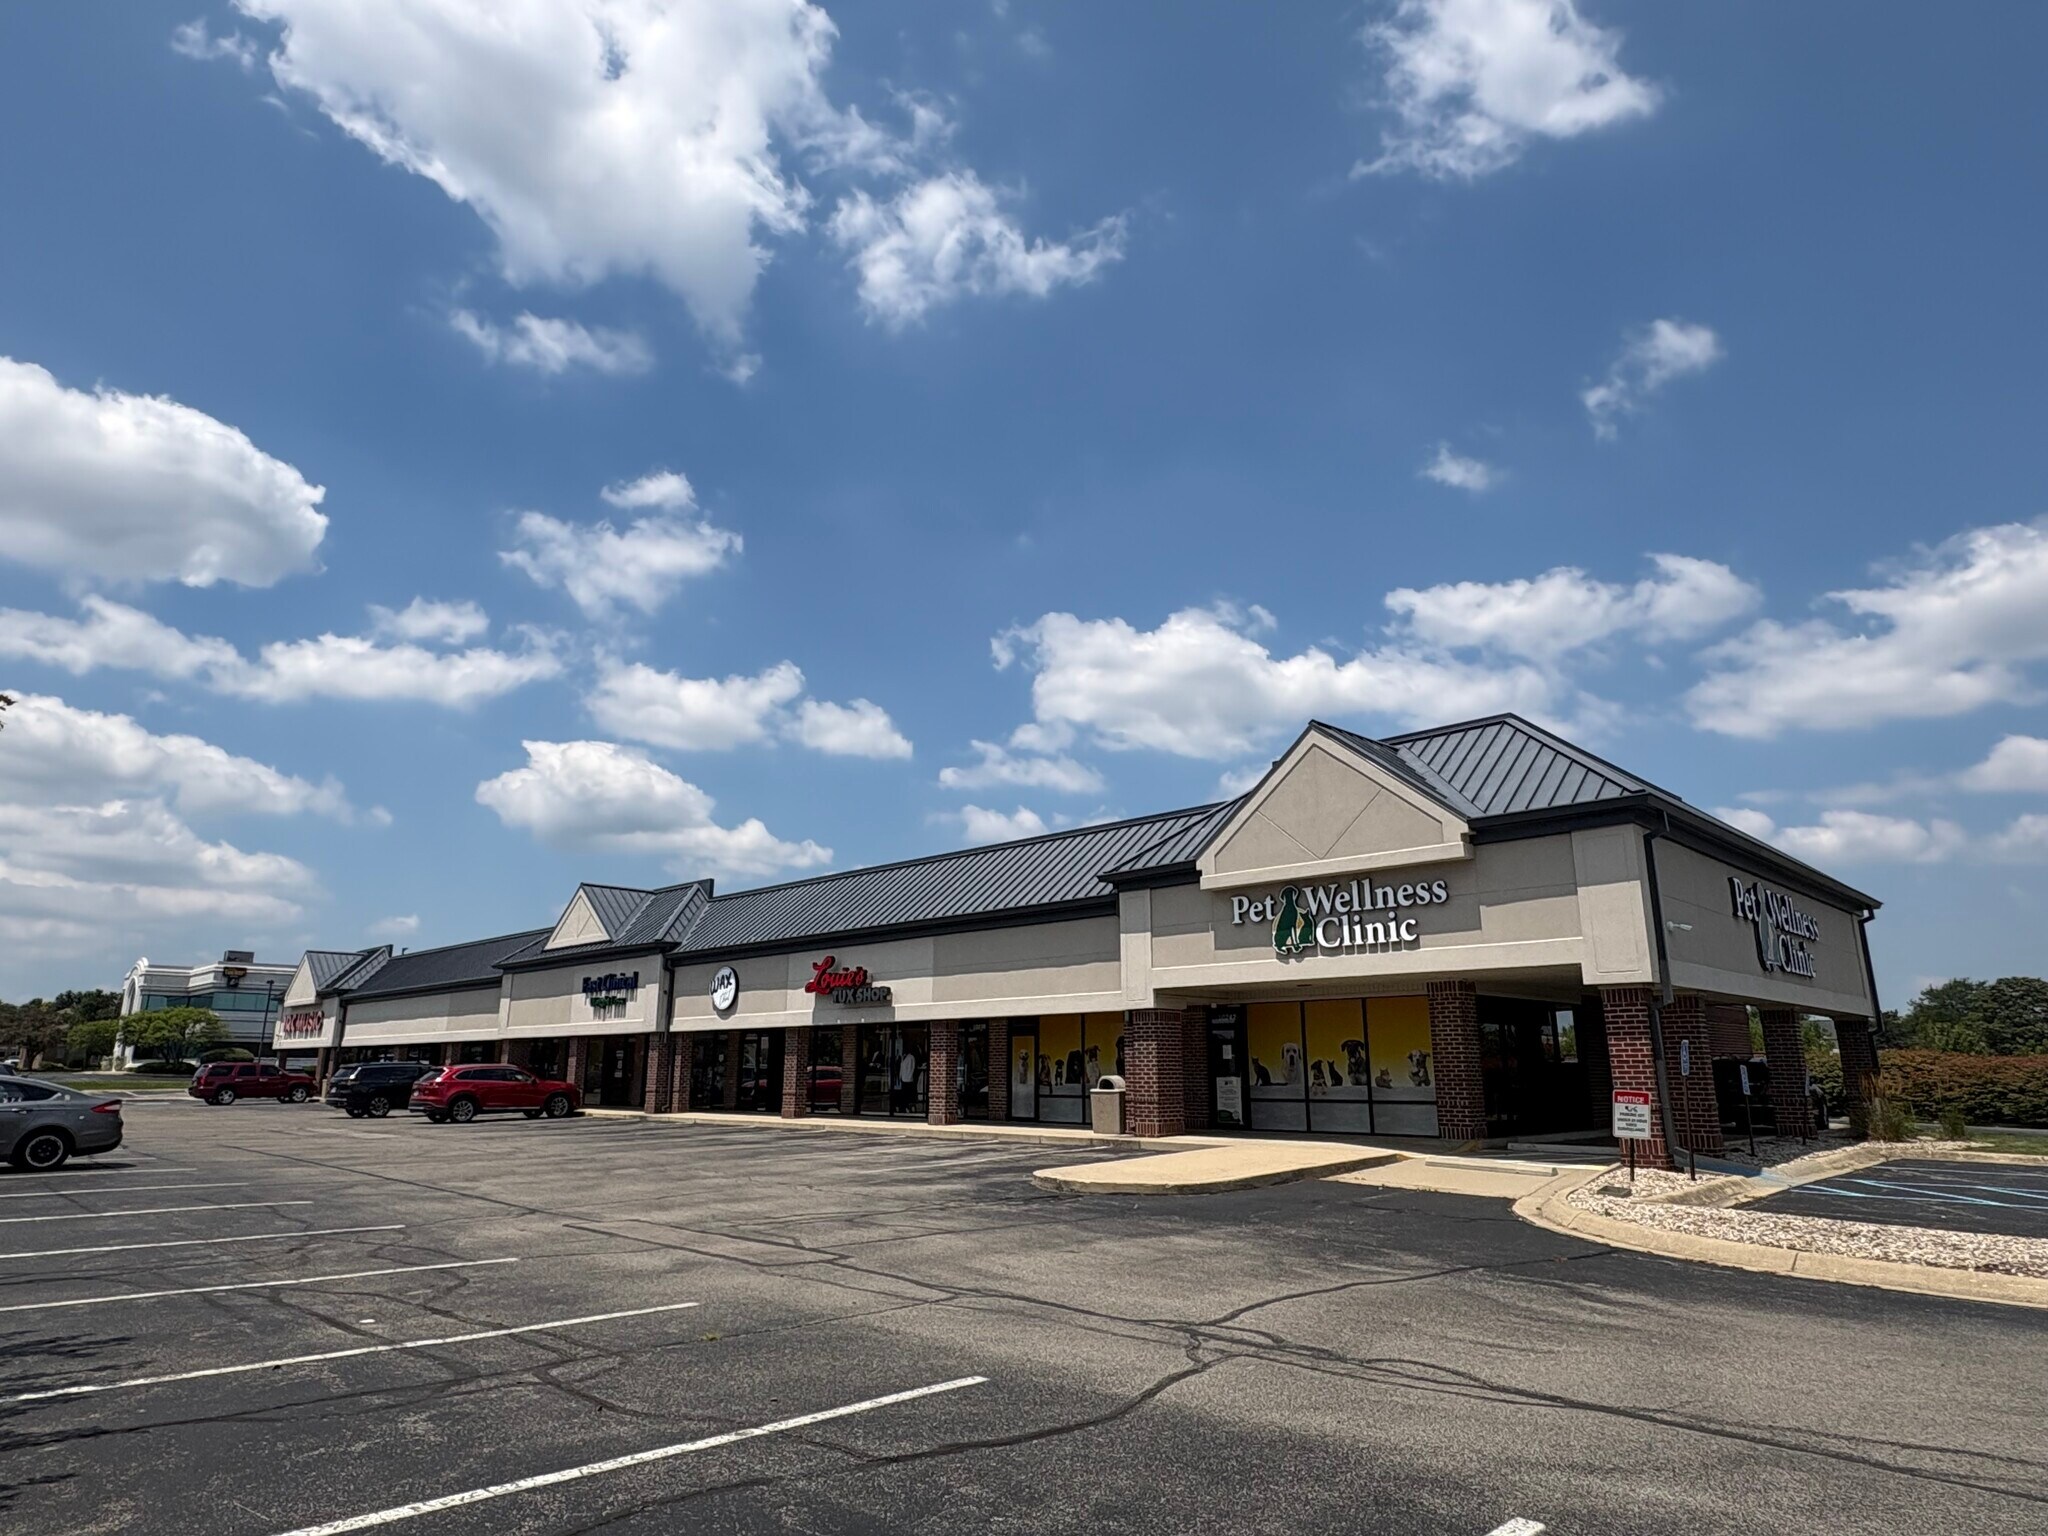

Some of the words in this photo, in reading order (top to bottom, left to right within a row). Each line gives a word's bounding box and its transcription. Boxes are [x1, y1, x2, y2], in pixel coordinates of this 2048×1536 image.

[1231, 895, 1276, 925] Pet
[1302, 877, 1448, 917] Wellness
[1730, 877, 1760, 922] Pet
[1766, 889, 1819, 941] Wellness
[1315, 911, 1418, 949] Clinic
[1779, 934, 1816, 978] Clinic
[832, 988, 855, 1004] TUX
[856, 986, 890, 1003] SHOP
[1617, 1095, 1645, 1104] NOTICE
